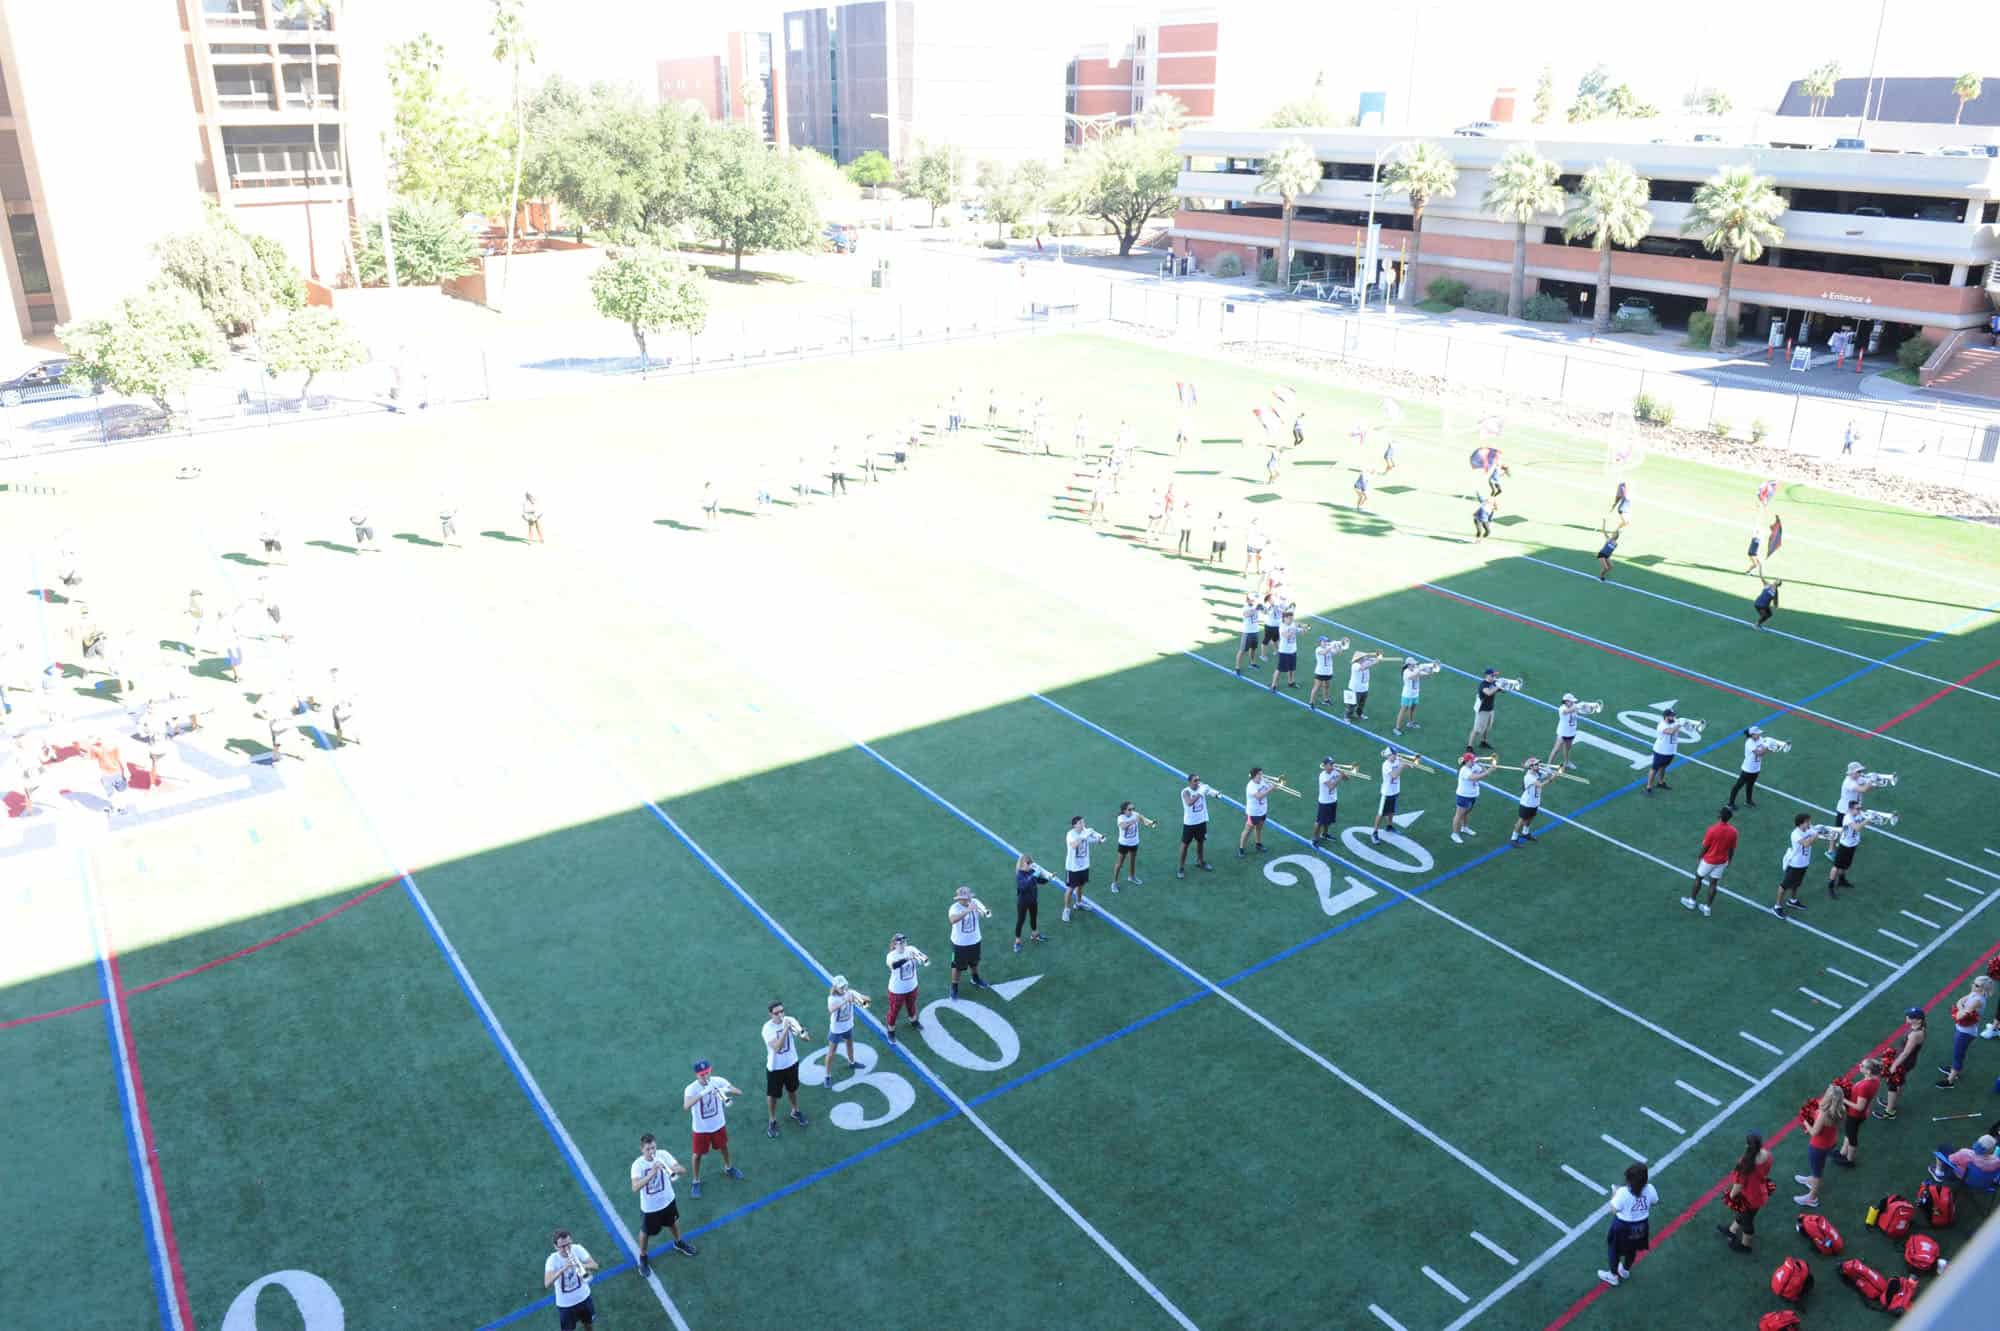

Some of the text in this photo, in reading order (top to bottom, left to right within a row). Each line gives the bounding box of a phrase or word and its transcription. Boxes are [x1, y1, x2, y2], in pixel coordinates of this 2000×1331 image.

[1829, 291, 1864, 303] Entrance
[1573, 710, 1702, 771] 10
[1263, 826, 1434, 916] 20
[798, 998, 1021, 1131] 30
